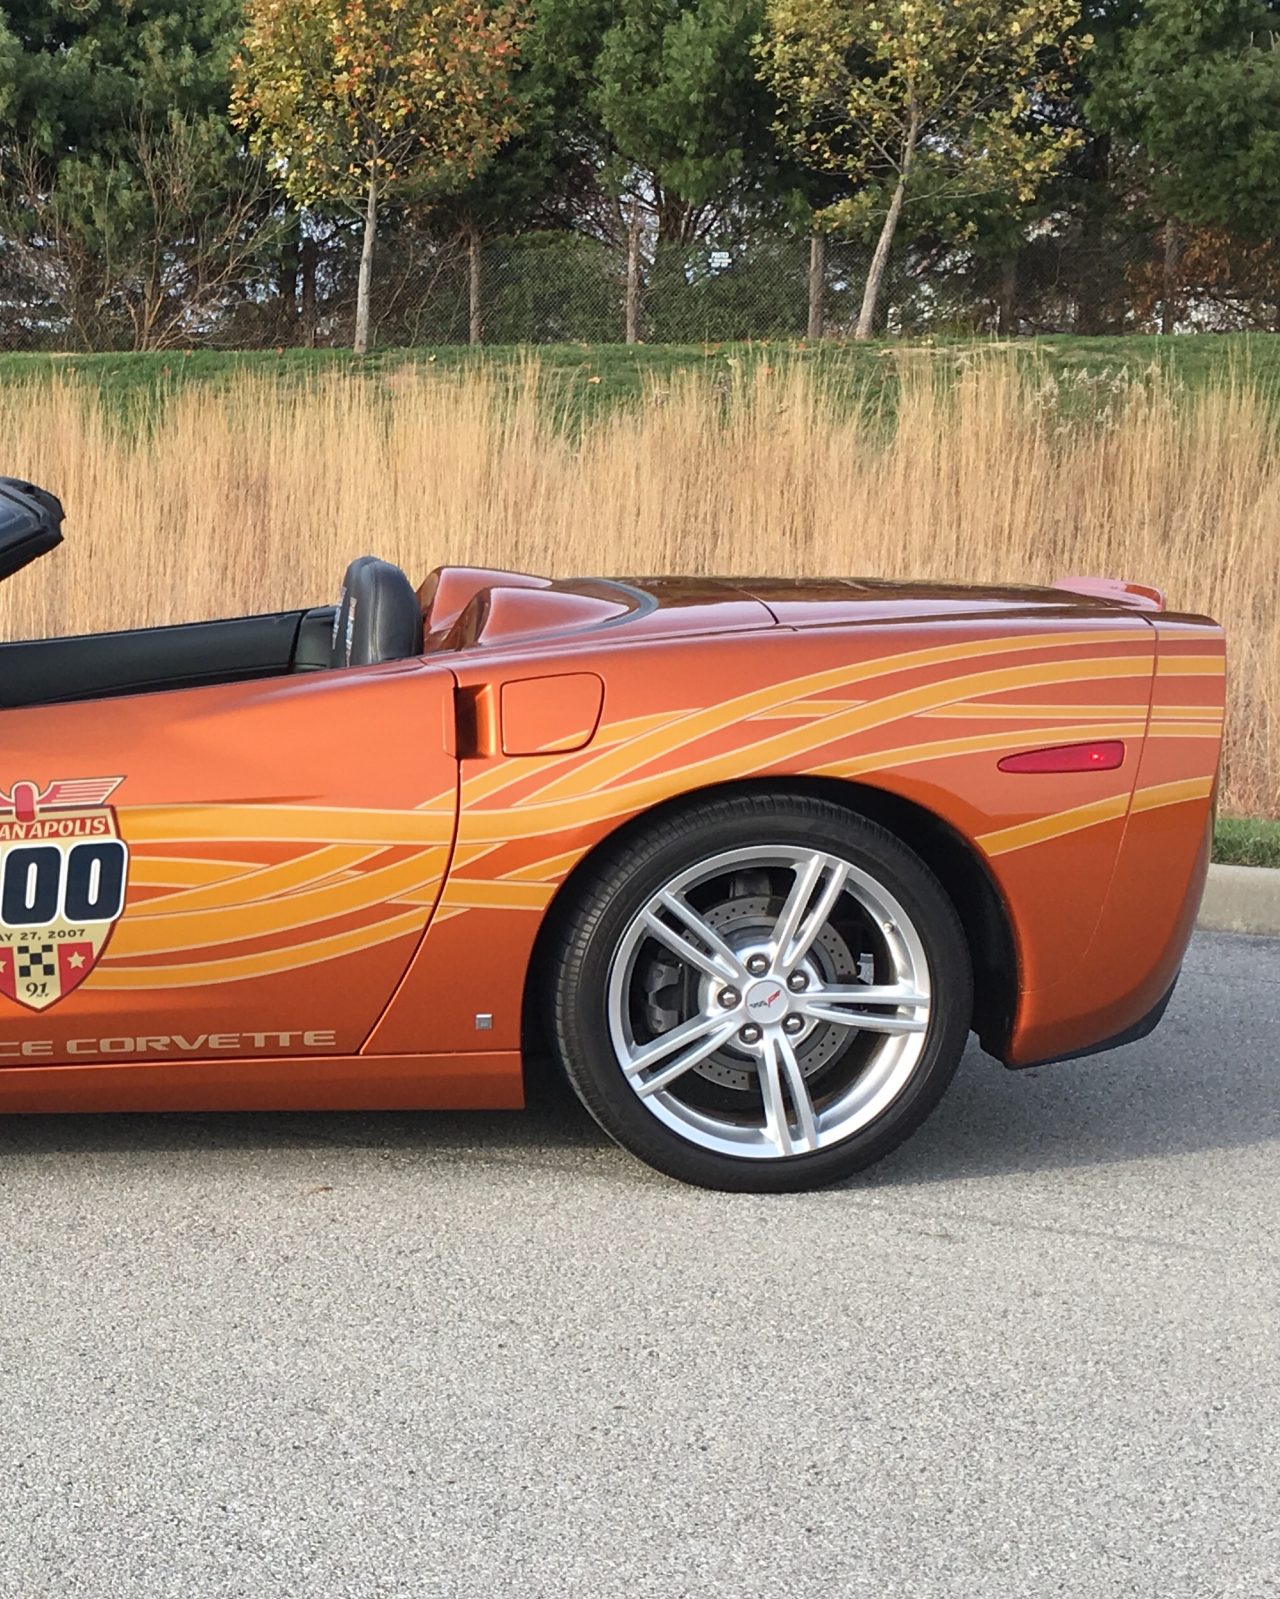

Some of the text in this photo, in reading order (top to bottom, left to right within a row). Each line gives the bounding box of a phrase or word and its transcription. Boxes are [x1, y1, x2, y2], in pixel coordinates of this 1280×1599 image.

[20, 931, 42, 941] 27,
[47, 928, 86, 939] 2007
[66, 1029, 338, 1054] CORVETTE
